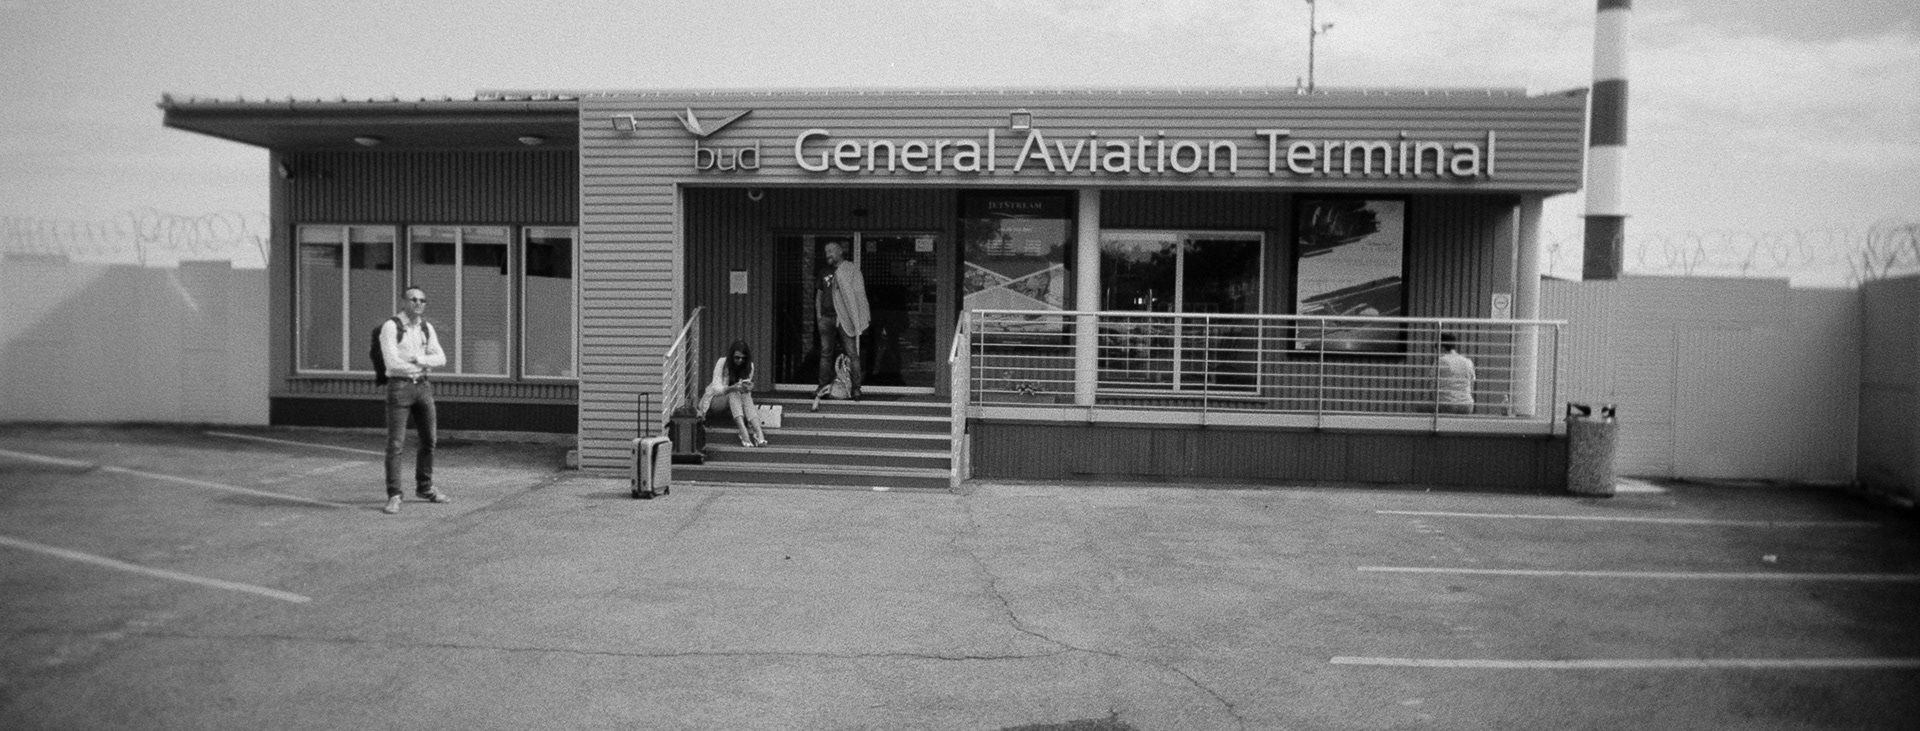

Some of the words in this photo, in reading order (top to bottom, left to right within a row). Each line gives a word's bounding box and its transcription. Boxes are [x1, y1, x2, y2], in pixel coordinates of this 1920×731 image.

[693, 139, 760, 171] bud
[794, 128, 996, 173] General
[1013, 128, 1239, 174] Aviation
[1255, 127, 1496, 177] Terminal
